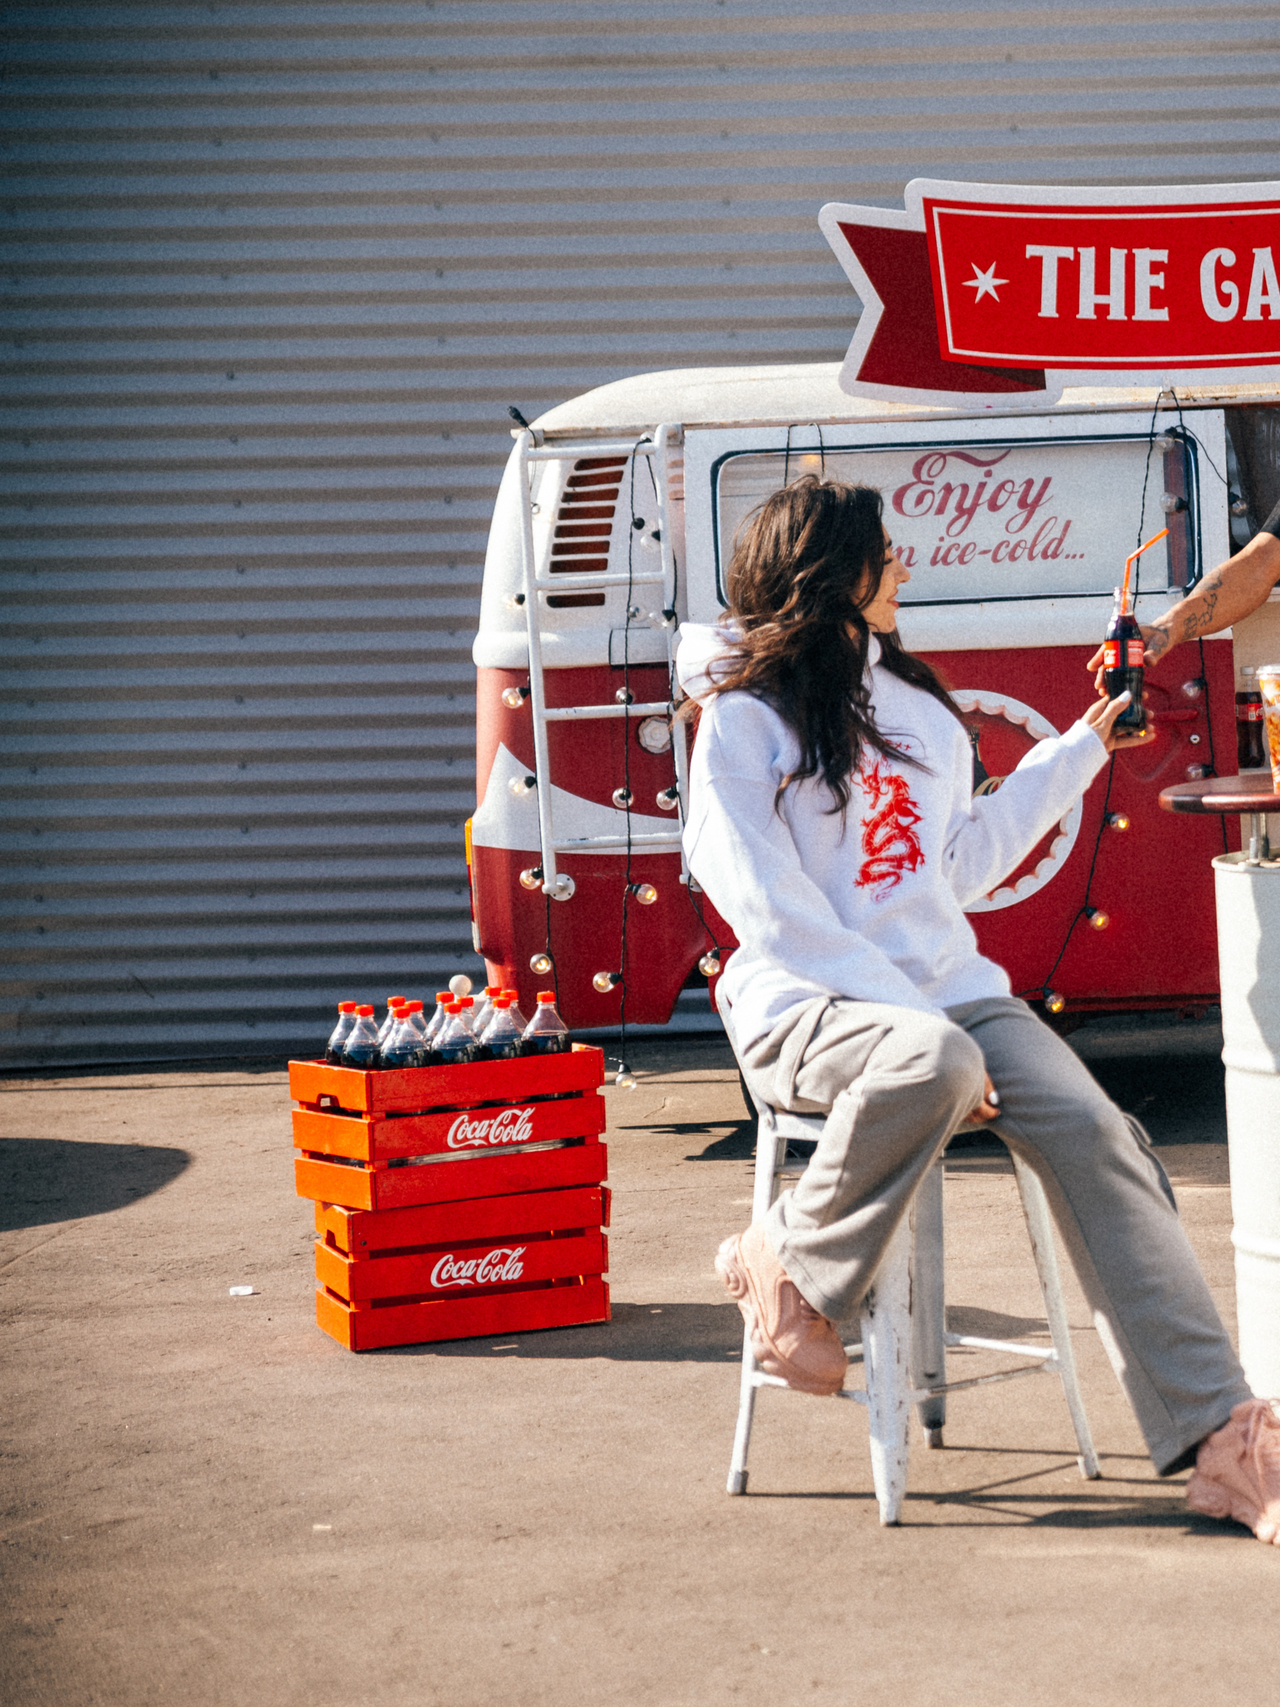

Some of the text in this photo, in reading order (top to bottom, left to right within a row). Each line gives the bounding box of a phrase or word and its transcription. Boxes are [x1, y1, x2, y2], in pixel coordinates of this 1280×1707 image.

[1026, 244, 1170, 322] THE
[891, 449, 1054, 538] Enjoy
[447, 1107, 536, 1149] Coca-Cola
[430, 1246, 527, 1289] Coca-Cola
